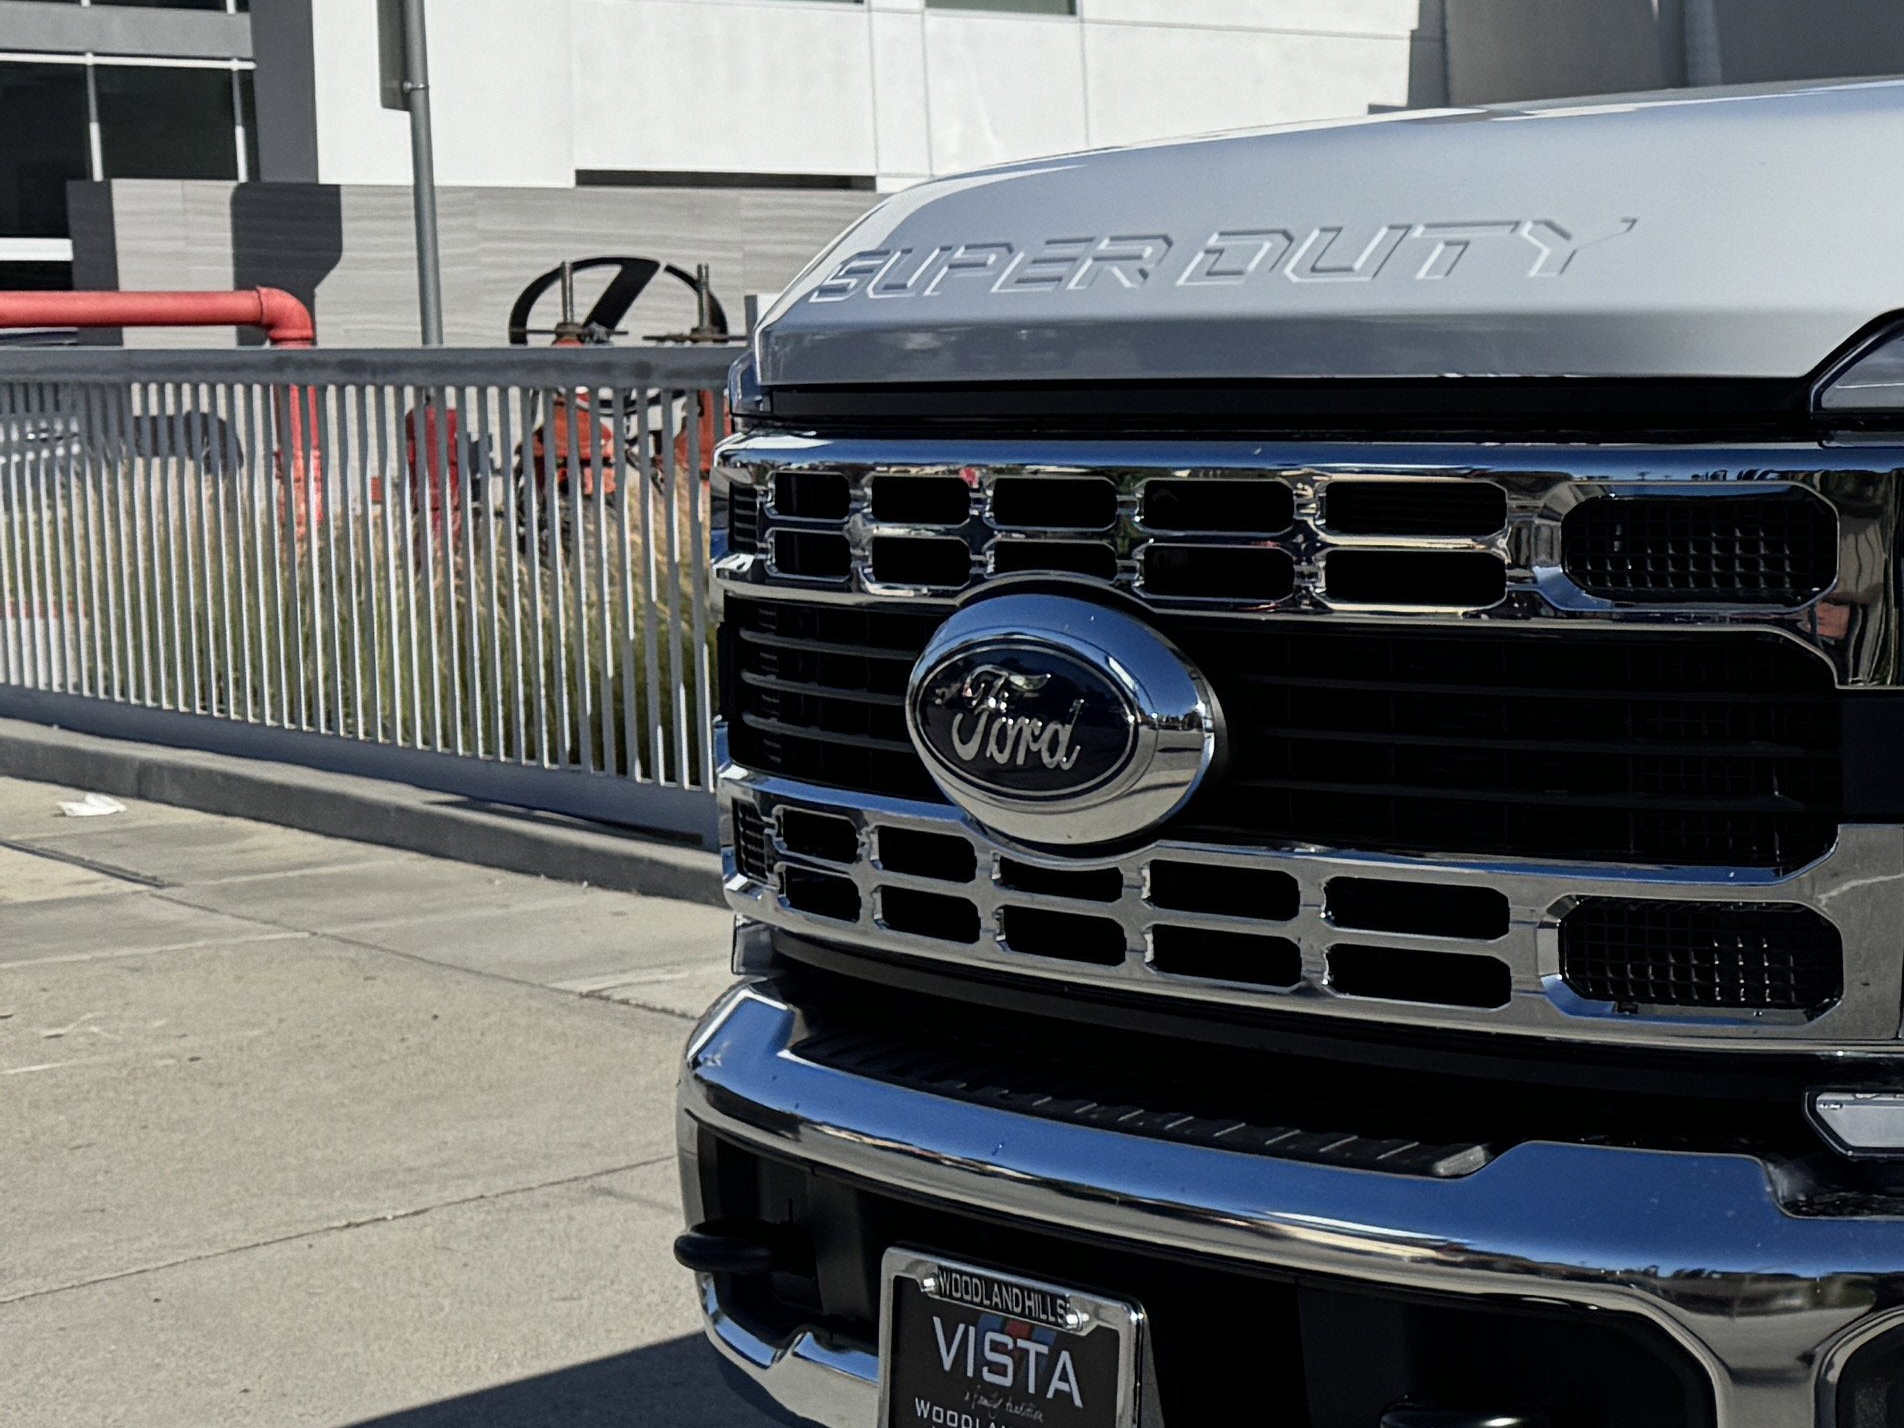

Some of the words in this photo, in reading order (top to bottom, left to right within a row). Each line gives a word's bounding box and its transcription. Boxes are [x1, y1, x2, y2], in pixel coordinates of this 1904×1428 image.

[809, 233, 1177, 303] SUPER
[1177, 218, 1638, 284] DUTY
[952, 664, 1083, 770] Ford
[938, 1269, 1023, 1319] WOODLAND
[1024, 1290, 1068, 1323] HILLS
[932, 1316, 1084, 1409] VISTA
